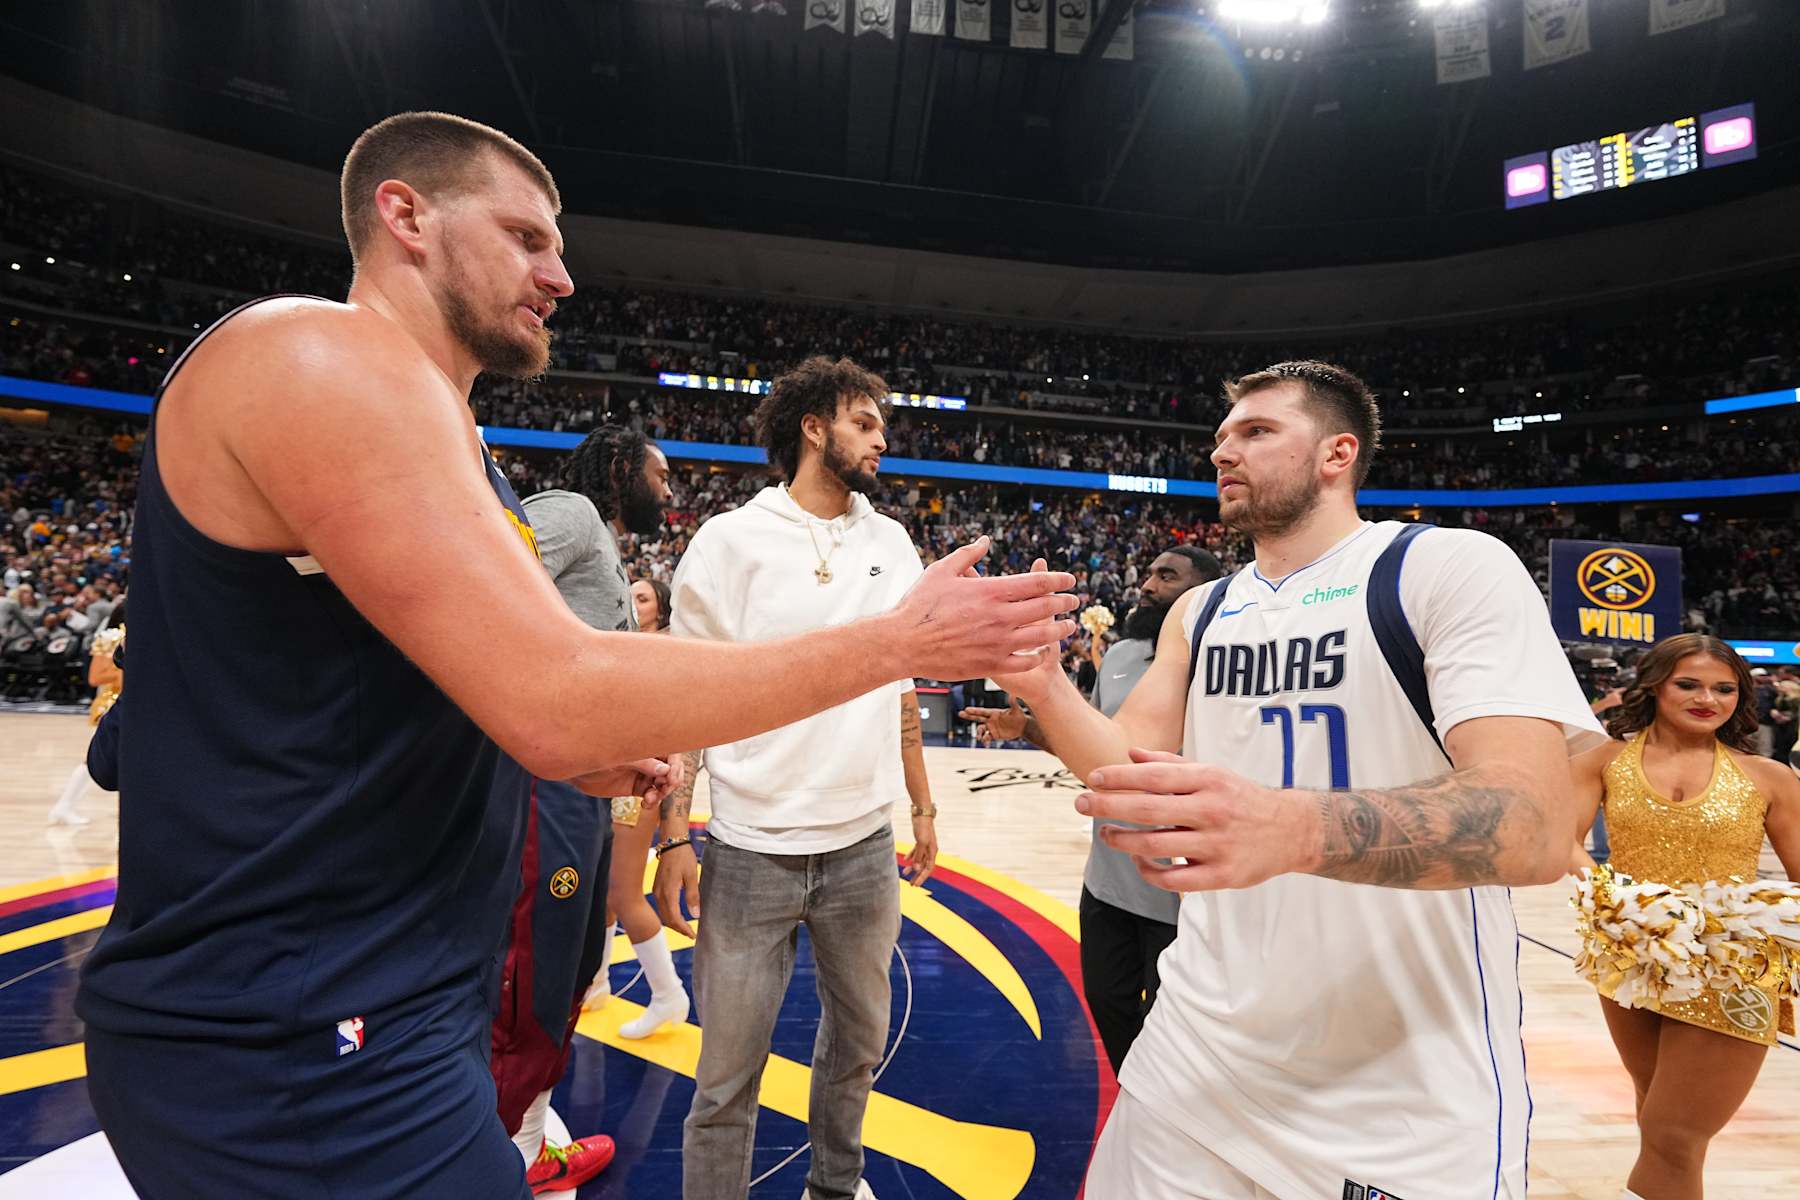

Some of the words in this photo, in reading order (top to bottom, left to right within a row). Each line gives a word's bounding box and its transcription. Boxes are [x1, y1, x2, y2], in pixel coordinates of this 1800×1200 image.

[1108, 474, 1168, 494] NUGGETS
[1302, 584, 1359, 606] chime
[1578, 607, 1655, 643] WIN!
[1204, 628, 1349, 697] DALLAS
[1259, 703, 1352, 792] 77
